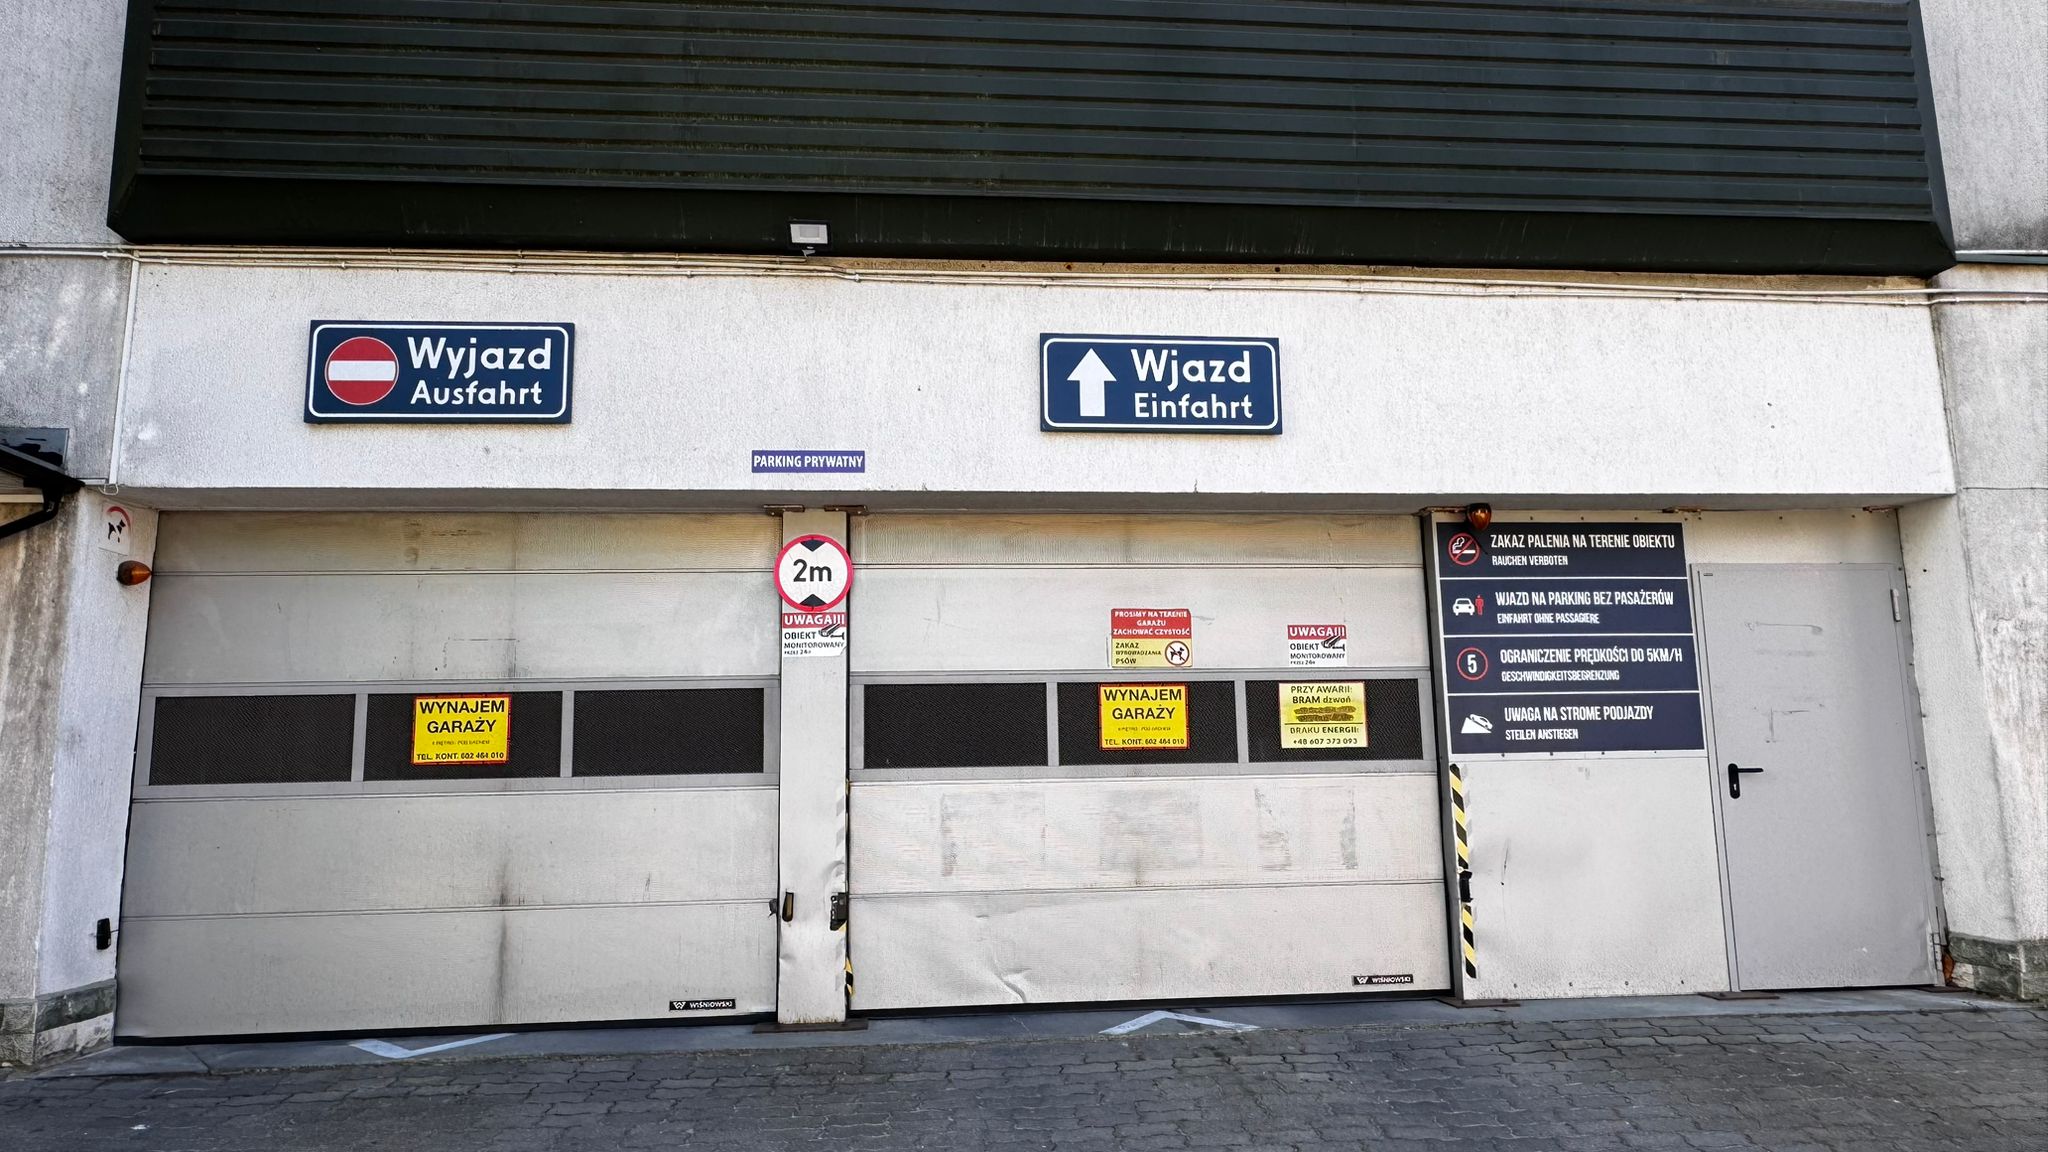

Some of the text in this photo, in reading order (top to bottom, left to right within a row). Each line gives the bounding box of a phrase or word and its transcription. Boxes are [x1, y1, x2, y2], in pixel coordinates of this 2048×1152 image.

[407, 337, 551, 379] Wyjazd
[1131, 349, 1251, 392] Wjazd
[410, 380, 542, 405] Ausfahrt
[1134, 392, 1253, 419] Einfahrt
[754, 455, 863, 468] PARKING PRYWATNY
[1491, 534, 1675, 549] ZAKAZ PALENIA NA TERENIE OBIEKTU
[1492, 555, 1568, 566] RAUCHEN VERBOTEN
[793, 559, 832, 582] 2m
[1495, 588, 1674, 606] WJAZD NA PARKING BEZ PASAŻERÓW
[1497, 613, 1600, 624] EINFAHRT OHNE PASSAGIERE
[784, 632, 816, 640] OBIEKT
[1154, 627, 1190, 635] CZYSTOŚĆ
[1500, 646, 1683, 666] OGRANICZENIE PRĘDKOŚCI DO 5KM/H
[1467, 654, 1477, 674] 5
[1501, 670, 1619, 682] GESCHWINDIGKEITSBEGRENZUNG
[1104, 689, 1182, 701] WYNAJEM
[1291, 685, 1352, 693] PRZY AWARII:
[420, 700, 505, 714] WYNAJEM
[1292, 696, 1320, 704] BRAM
[1112, 704, 1176, 719] GARAŻY
[1504, 705, 1653, 722] UWAGA NA STROME PODJAZDY
[427, 716, 496, 733] GARAŻY
[1505, 728, 1579, 740] STEILEN ANSTIEGEN
[490, 751, 504, 759] 010
